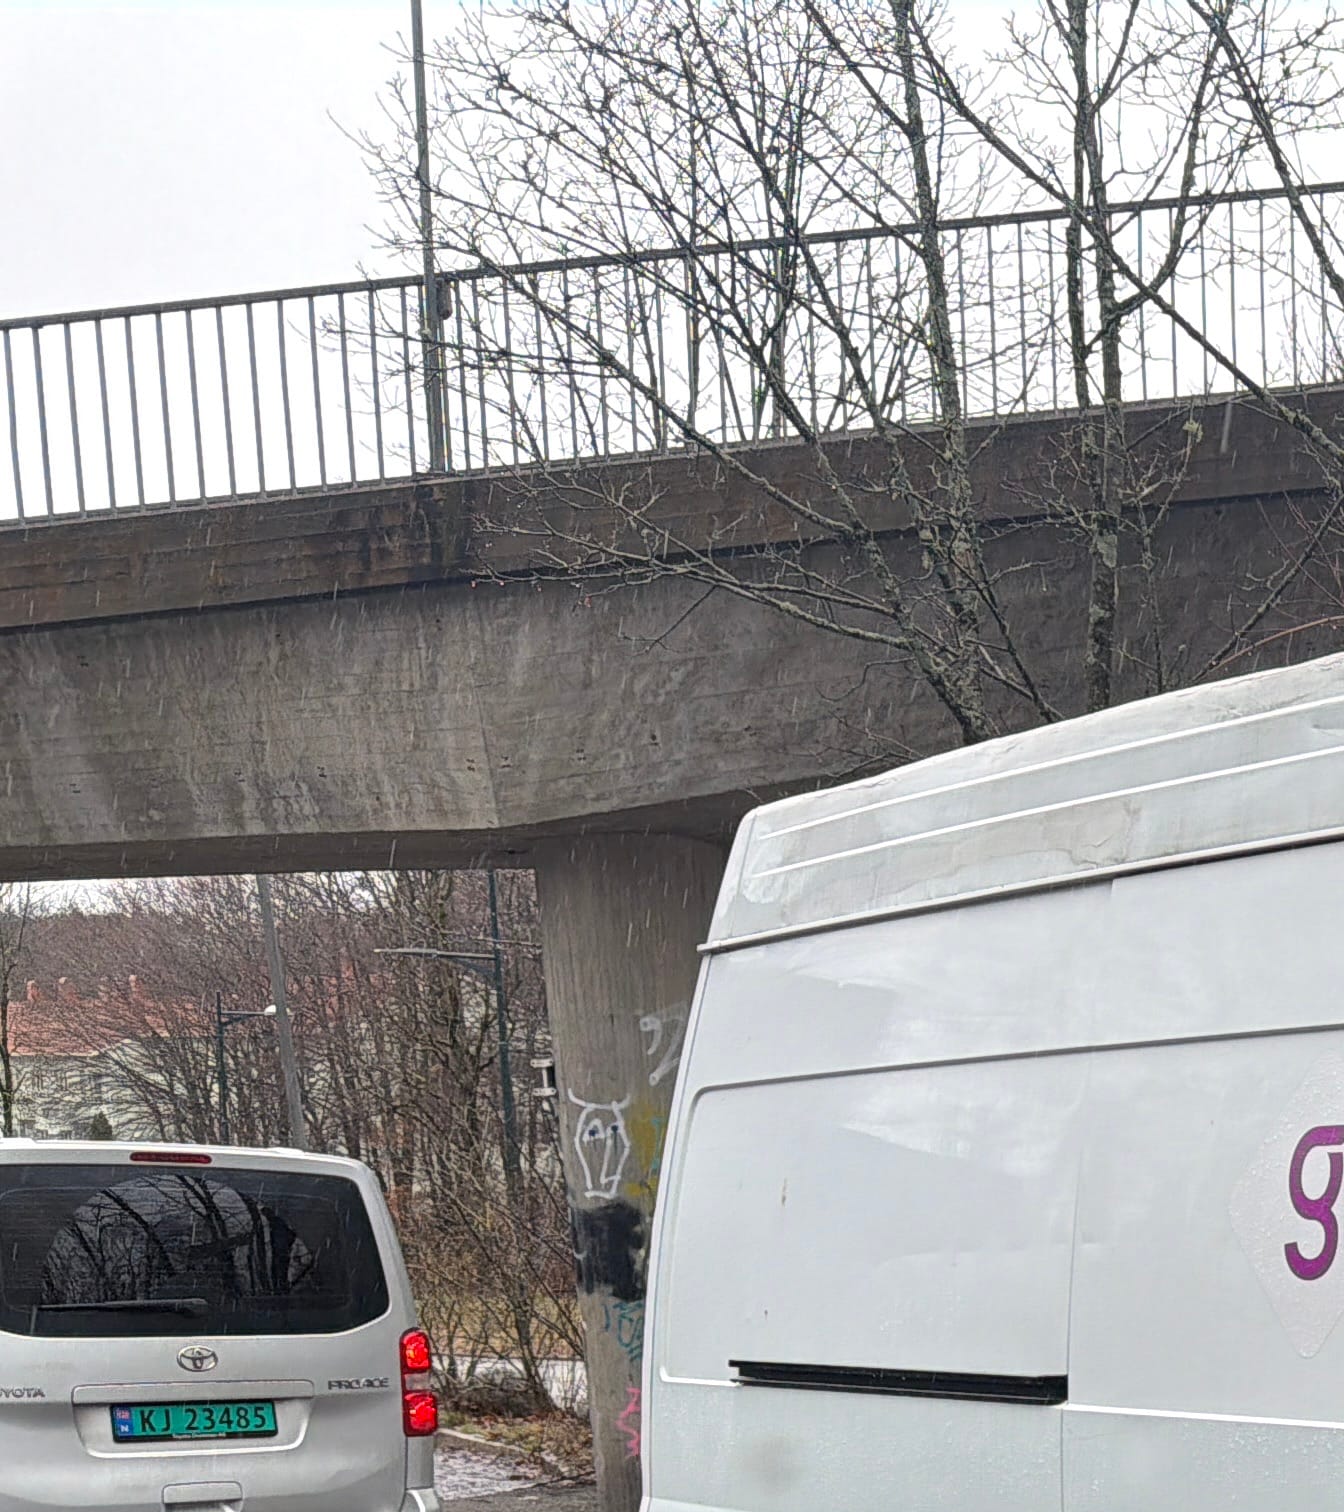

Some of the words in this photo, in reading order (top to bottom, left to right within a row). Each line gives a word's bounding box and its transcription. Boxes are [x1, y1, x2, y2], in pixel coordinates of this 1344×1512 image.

[0, 1387, 46, 1399] YOTA
[139, 1408, 172, 1433] KJ
[184, 1406, 267, 1431] 23485
